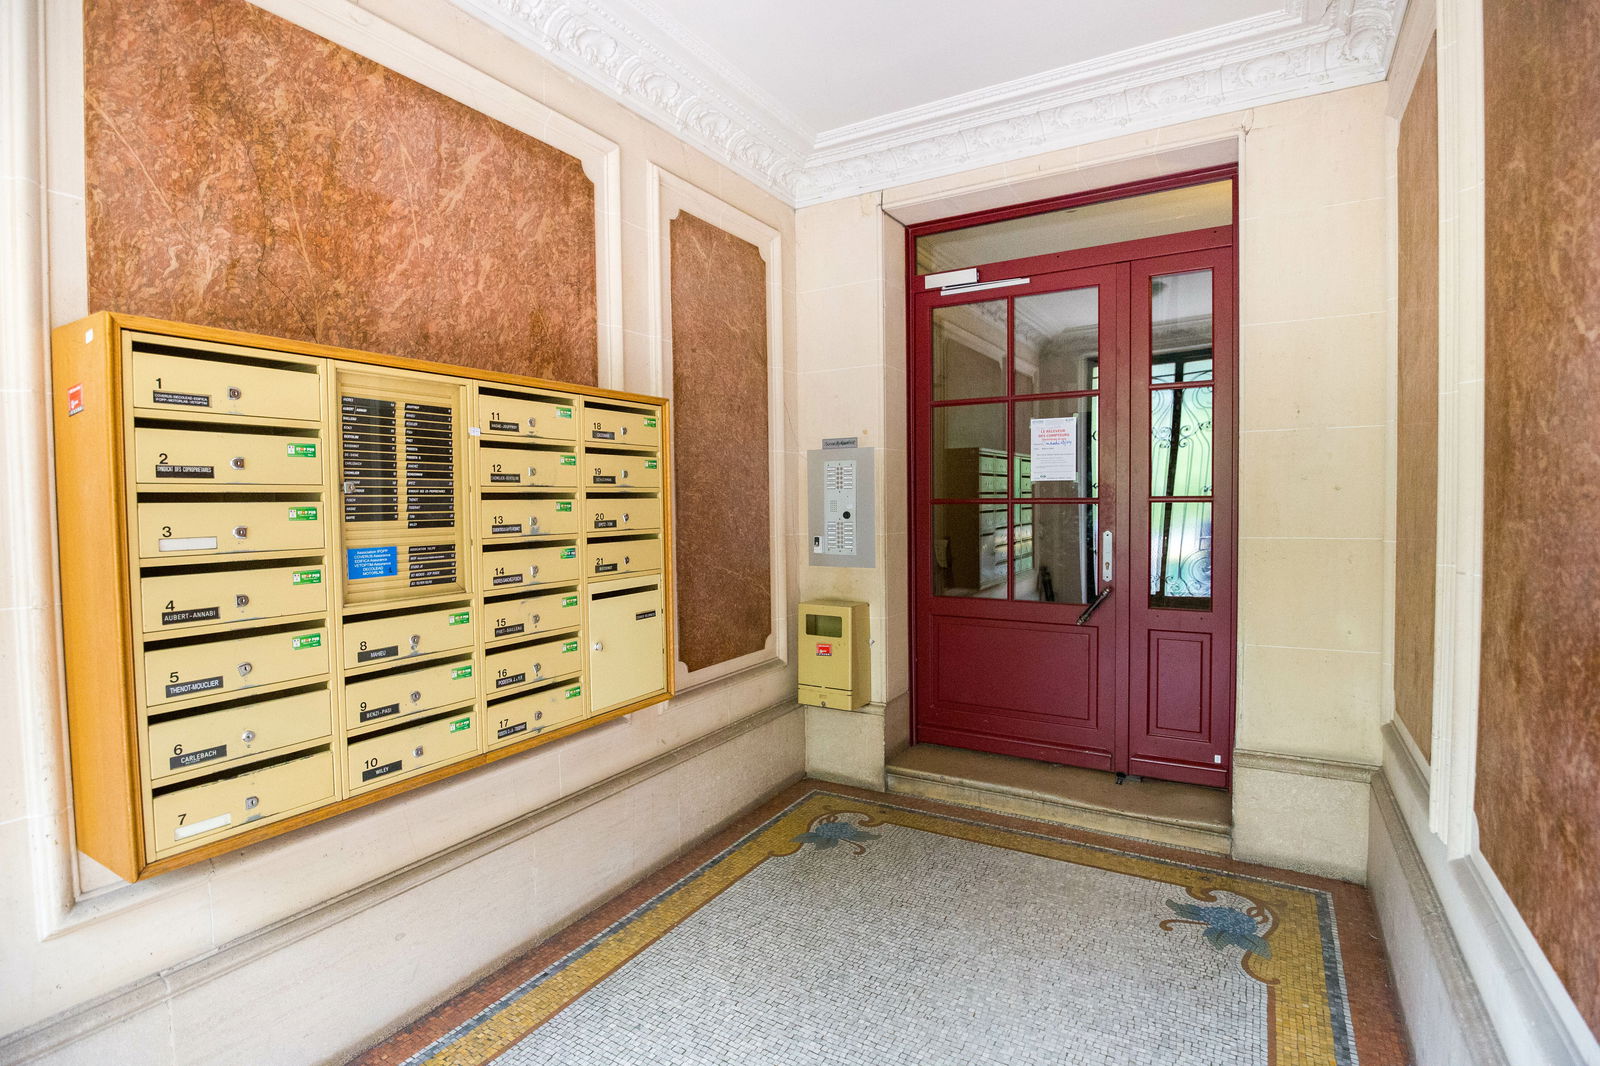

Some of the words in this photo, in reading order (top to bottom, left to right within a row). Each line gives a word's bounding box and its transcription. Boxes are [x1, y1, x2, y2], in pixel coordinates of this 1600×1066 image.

[156, 378, 161, 389] 1
[492, 412, 500, 420] 11
[159, 453, 168, 464] 2
[492, 464, 501, 472] 12
[494, 516, 504, 524] 13
[162, 526, 172, 538] 3
[165, 600, 175, 611] 4
[496, 618, 506, 627] 15
[360, 641, 367, 651] 8
[170, 672, 179, 683] 5
[497, 669, 507, 678] 16
[360, 702, 367, 711] 9
[500, 719, 508, 728] 17
[174, 744, 182, 755] 6
[180, 750, 217, 763] CARLEBACH
[364, 758, 378, 769] 10
[178, 813, 186, 825] 7
